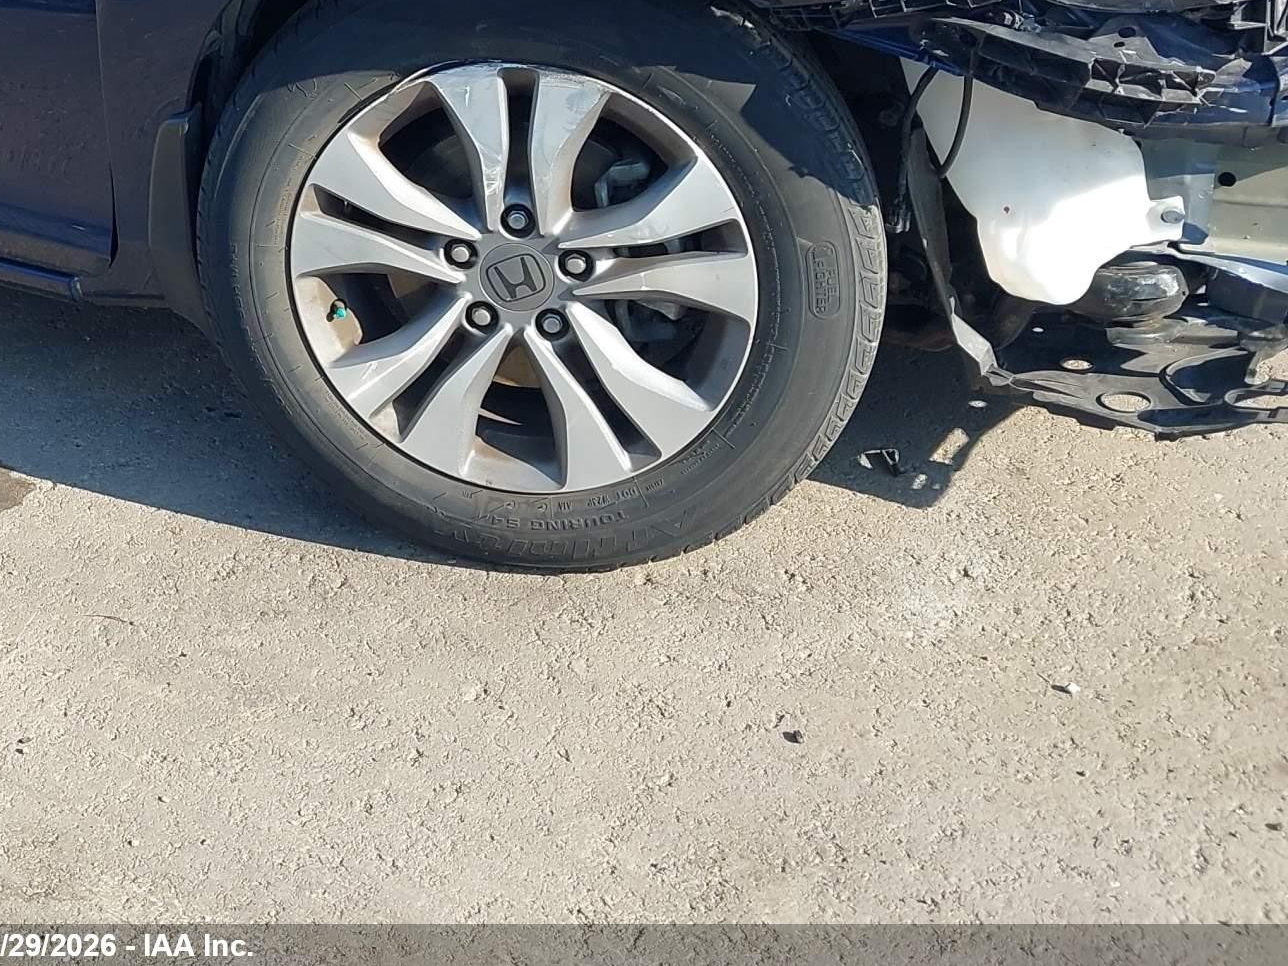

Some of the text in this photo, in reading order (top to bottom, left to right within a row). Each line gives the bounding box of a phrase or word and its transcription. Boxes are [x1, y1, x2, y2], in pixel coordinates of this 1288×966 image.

[815, 259, 827, 314] FIGHTER
[826, 268, 837, 303] FUEL
[489, 511, 630, 532] TOURING S4
